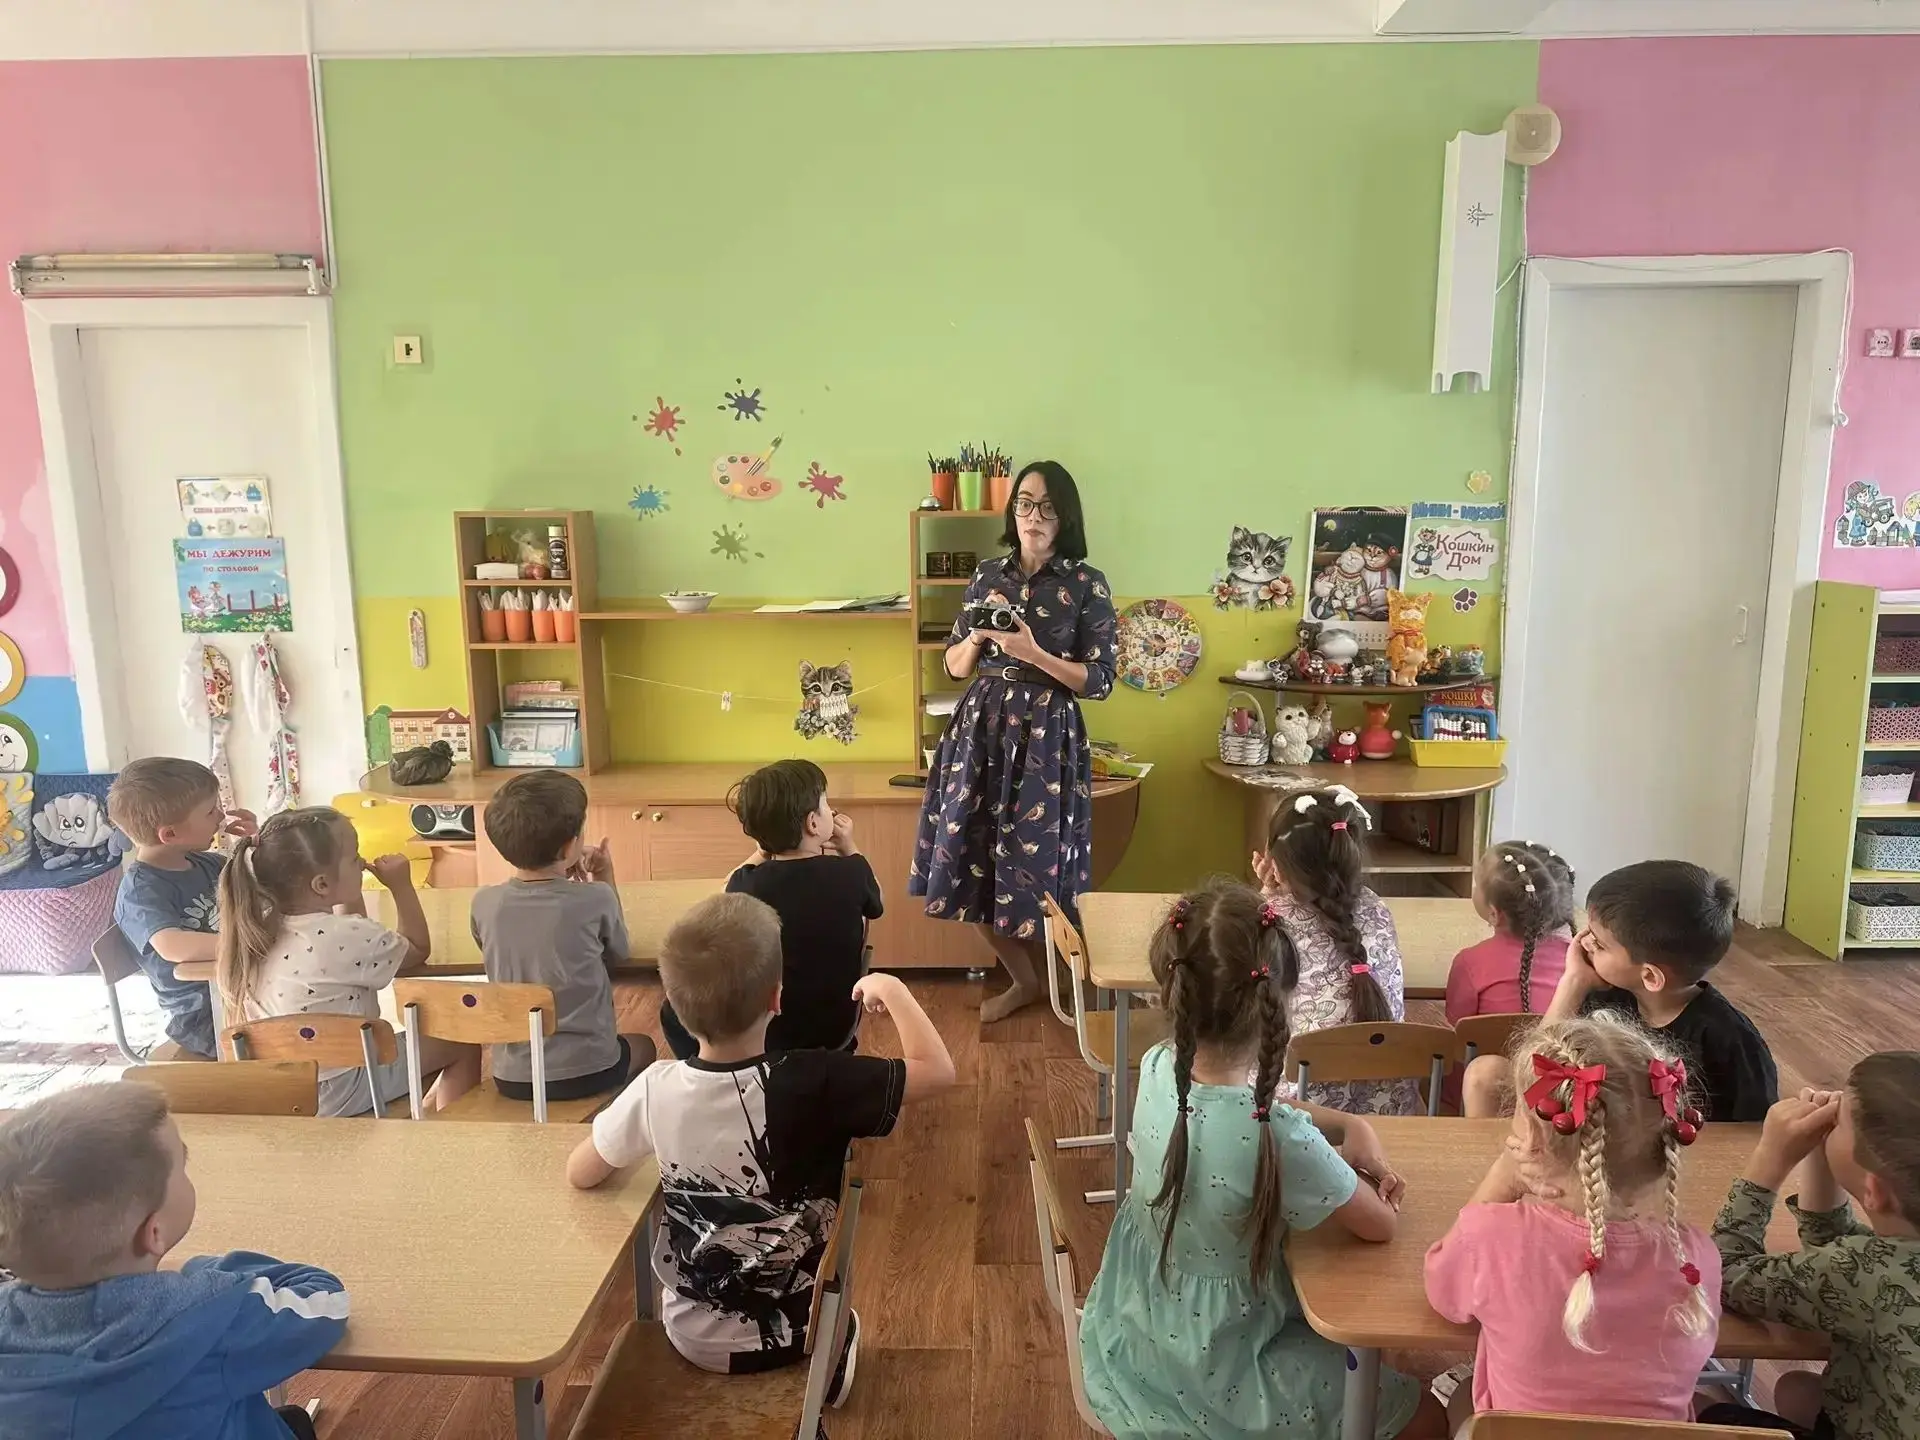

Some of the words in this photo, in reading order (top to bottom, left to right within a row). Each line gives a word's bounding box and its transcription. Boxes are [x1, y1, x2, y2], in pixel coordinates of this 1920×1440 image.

[1436, 534, 1495, 554] Кошкин
[187, 549, 207, 558] МЫ
[212, 549, 272, 558] ДЕЖУРИМ
[1446, 552, 1481, 571] Дом
[1441, 691, 1478, 701] КОШКИ
